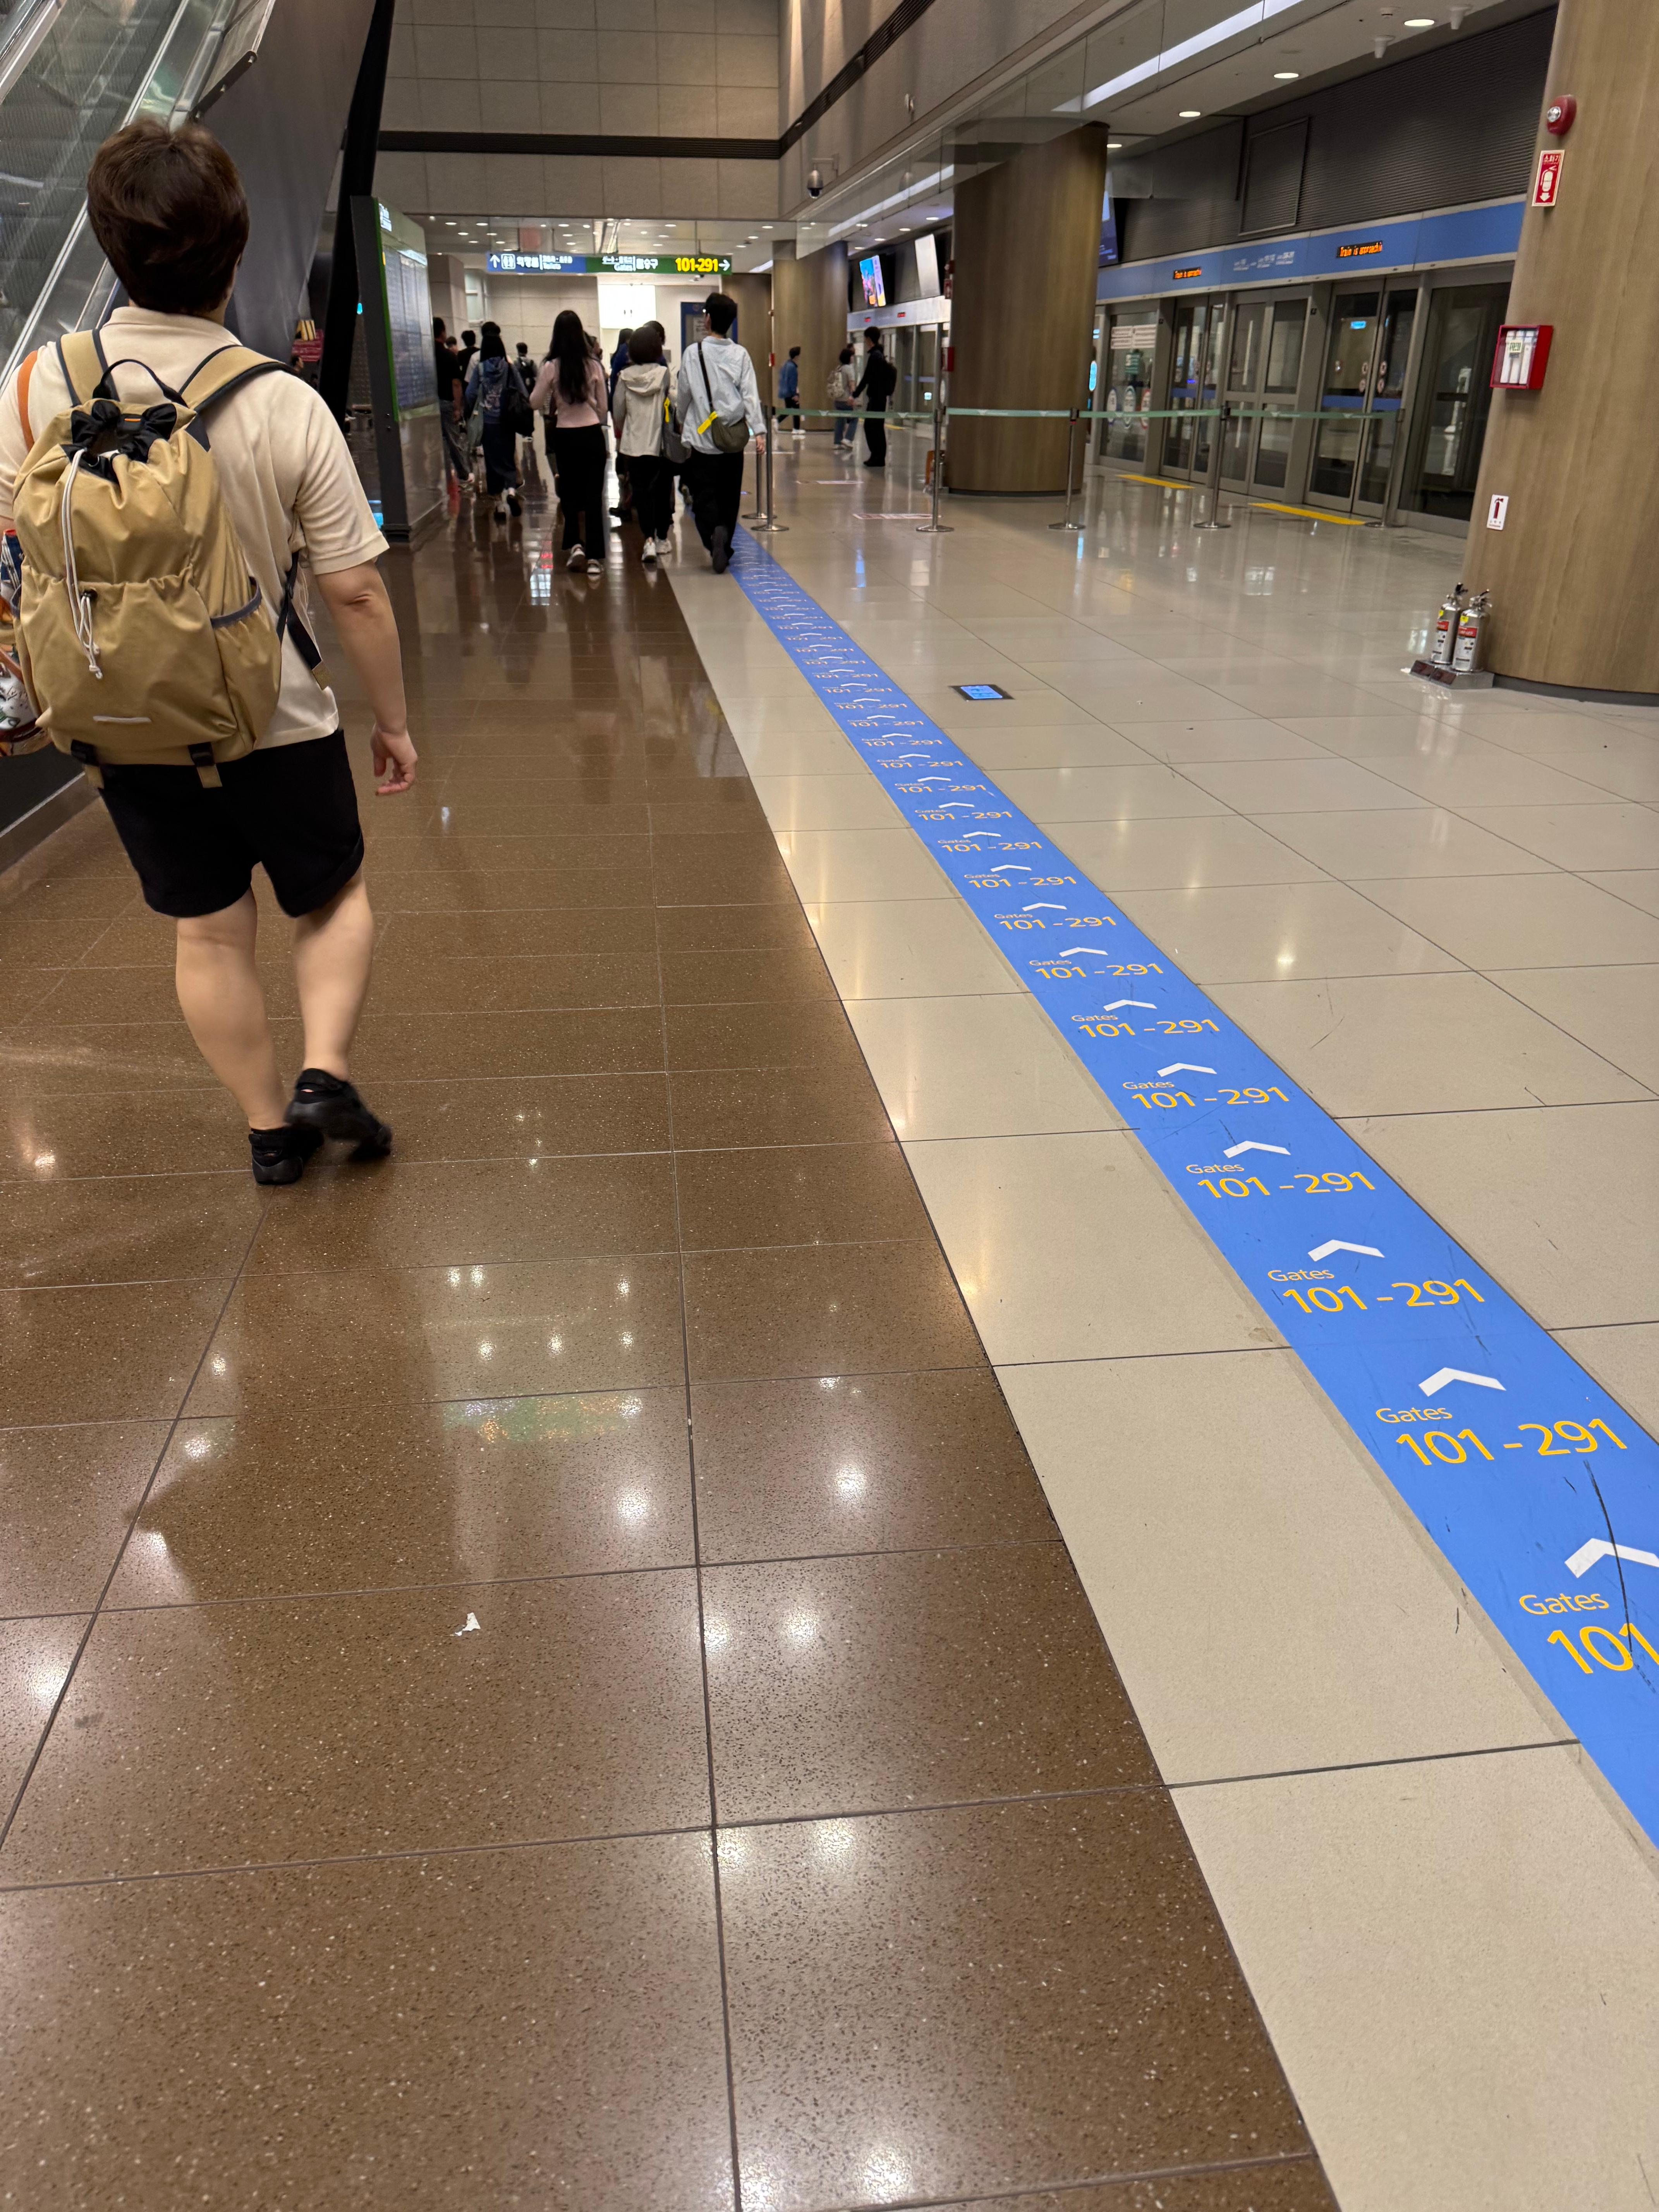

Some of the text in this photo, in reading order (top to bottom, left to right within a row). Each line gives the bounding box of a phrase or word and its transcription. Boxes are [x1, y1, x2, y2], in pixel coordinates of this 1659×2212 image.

[675, 258, 718, 272] 101-291
[1071, 1014, 1118, 1022] Gates
[1122, 1082, 1175, 1090] Gates
[1185, 1164, 1244, 1174] Gates
[1267, 1269, 1335, 1282] Gates
[1375, 1407, 1453, 1424] Gates
[1518, 1593, 1609, 1616] Gates
[1546, 1623, 1659, 1674] 101
